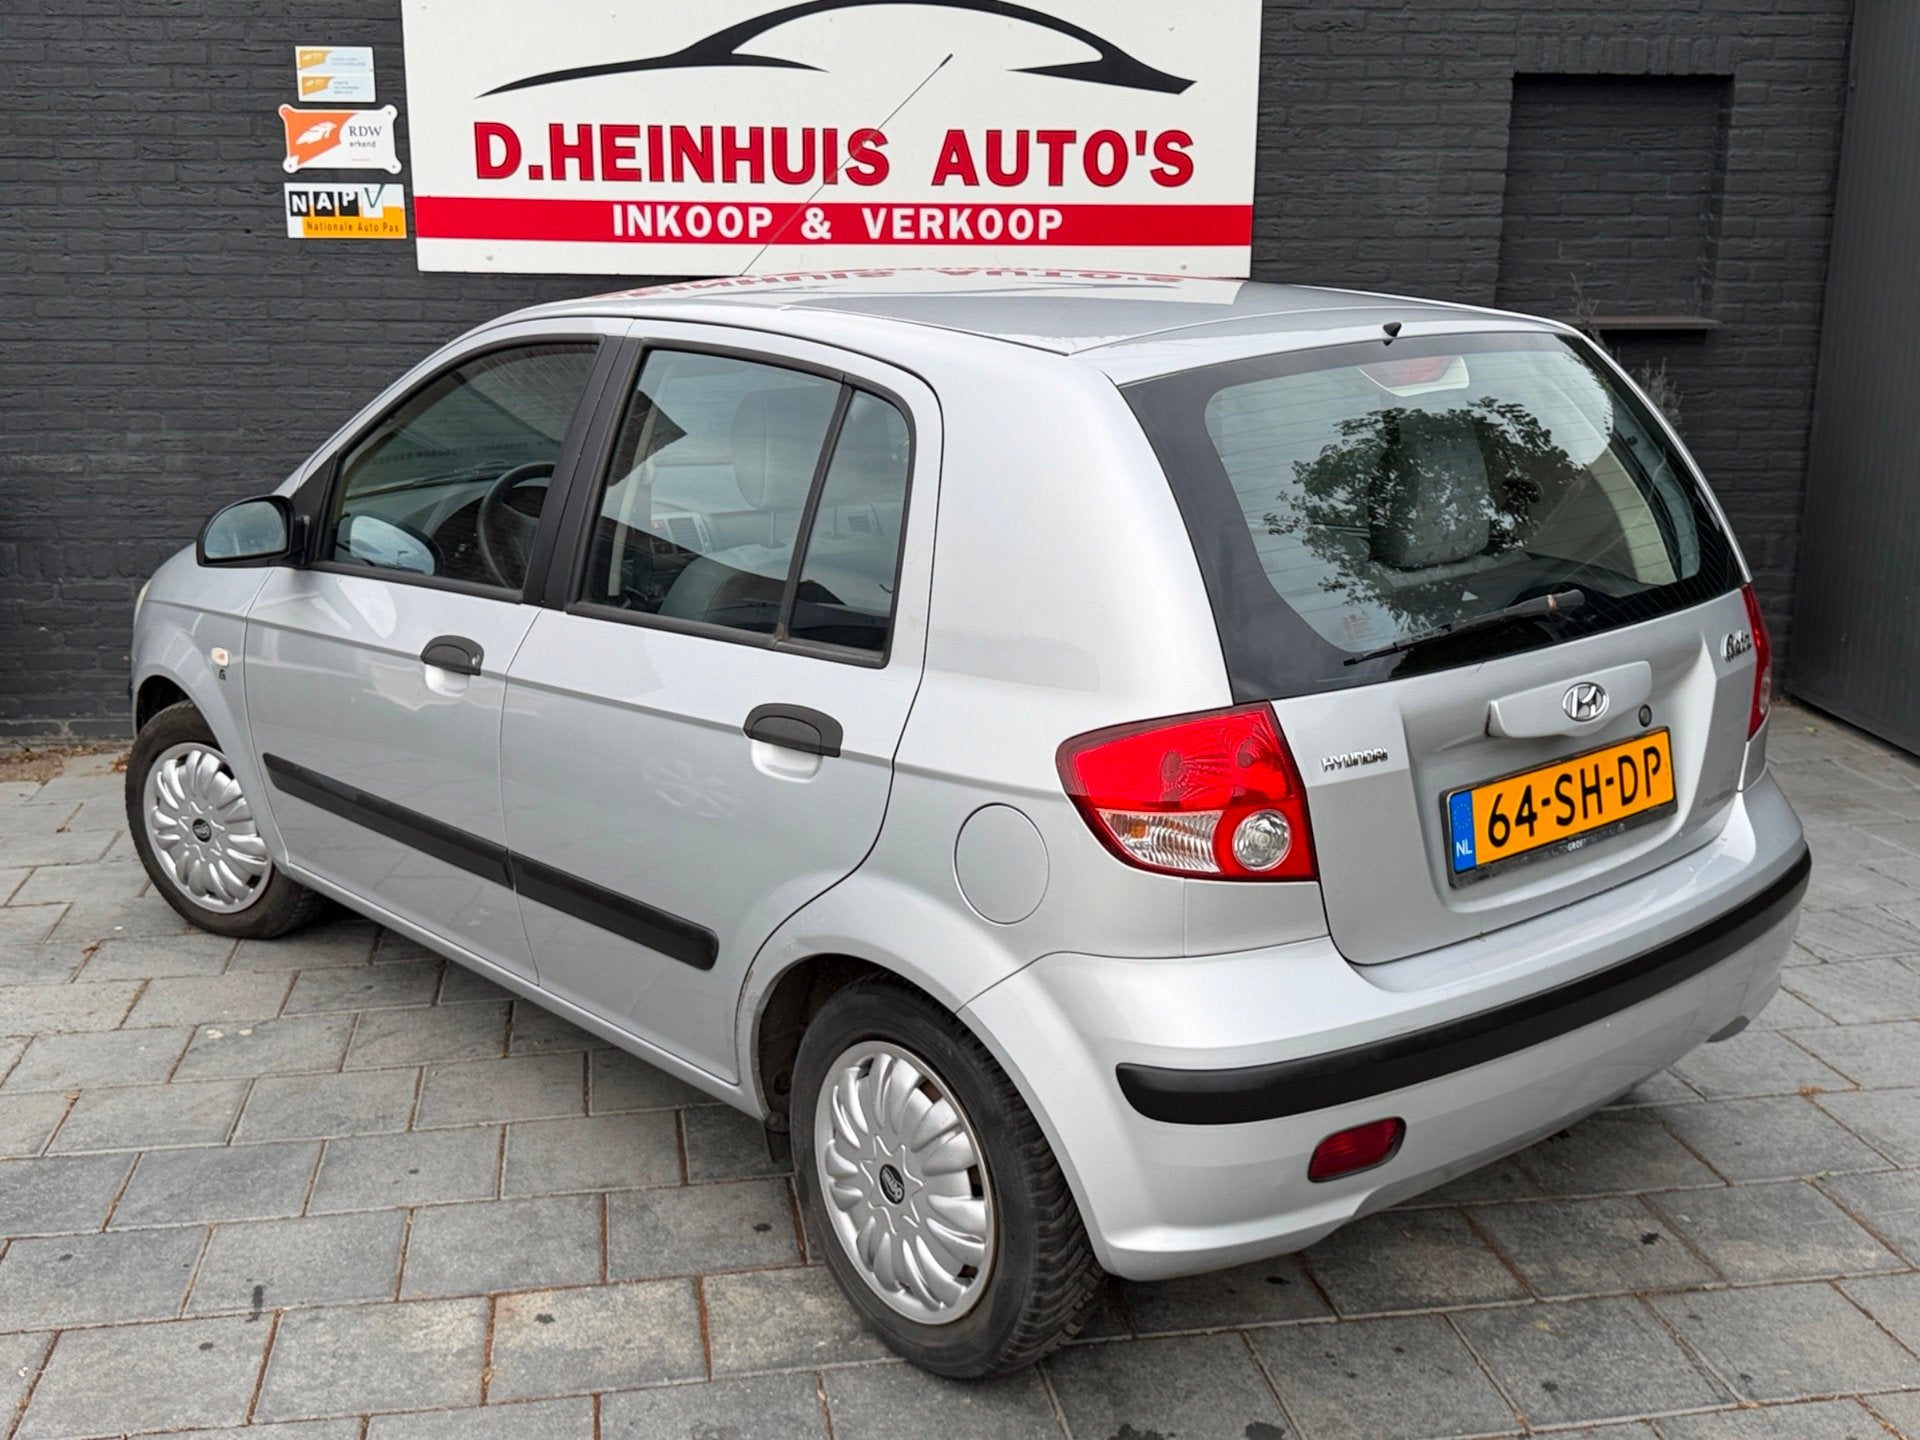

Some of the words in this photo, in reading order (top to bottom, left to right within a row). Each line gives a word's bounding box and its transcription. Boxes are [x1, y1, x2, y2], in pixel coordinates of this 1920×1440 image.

[349, 125, 382, 137] RDW
[349, 140, 376, 149] erkend
[473, 121, 890, 187] D.HEINHUIS
[930, 128, 1195, 188] AUTO'S
[307, 221, 353, 232] Nationale
[357, 221, 379, 233] Auto
[382, 221, 399, 233] Pas
[612, 203, 773, 239] INKOOP
[800, 206, 832, 240] &
[861, 207, 1064, 241] VERKOOP
[1487, 745, 1662, 848] 64-SH-DP
[1455, 838, 1474, 858] NL
